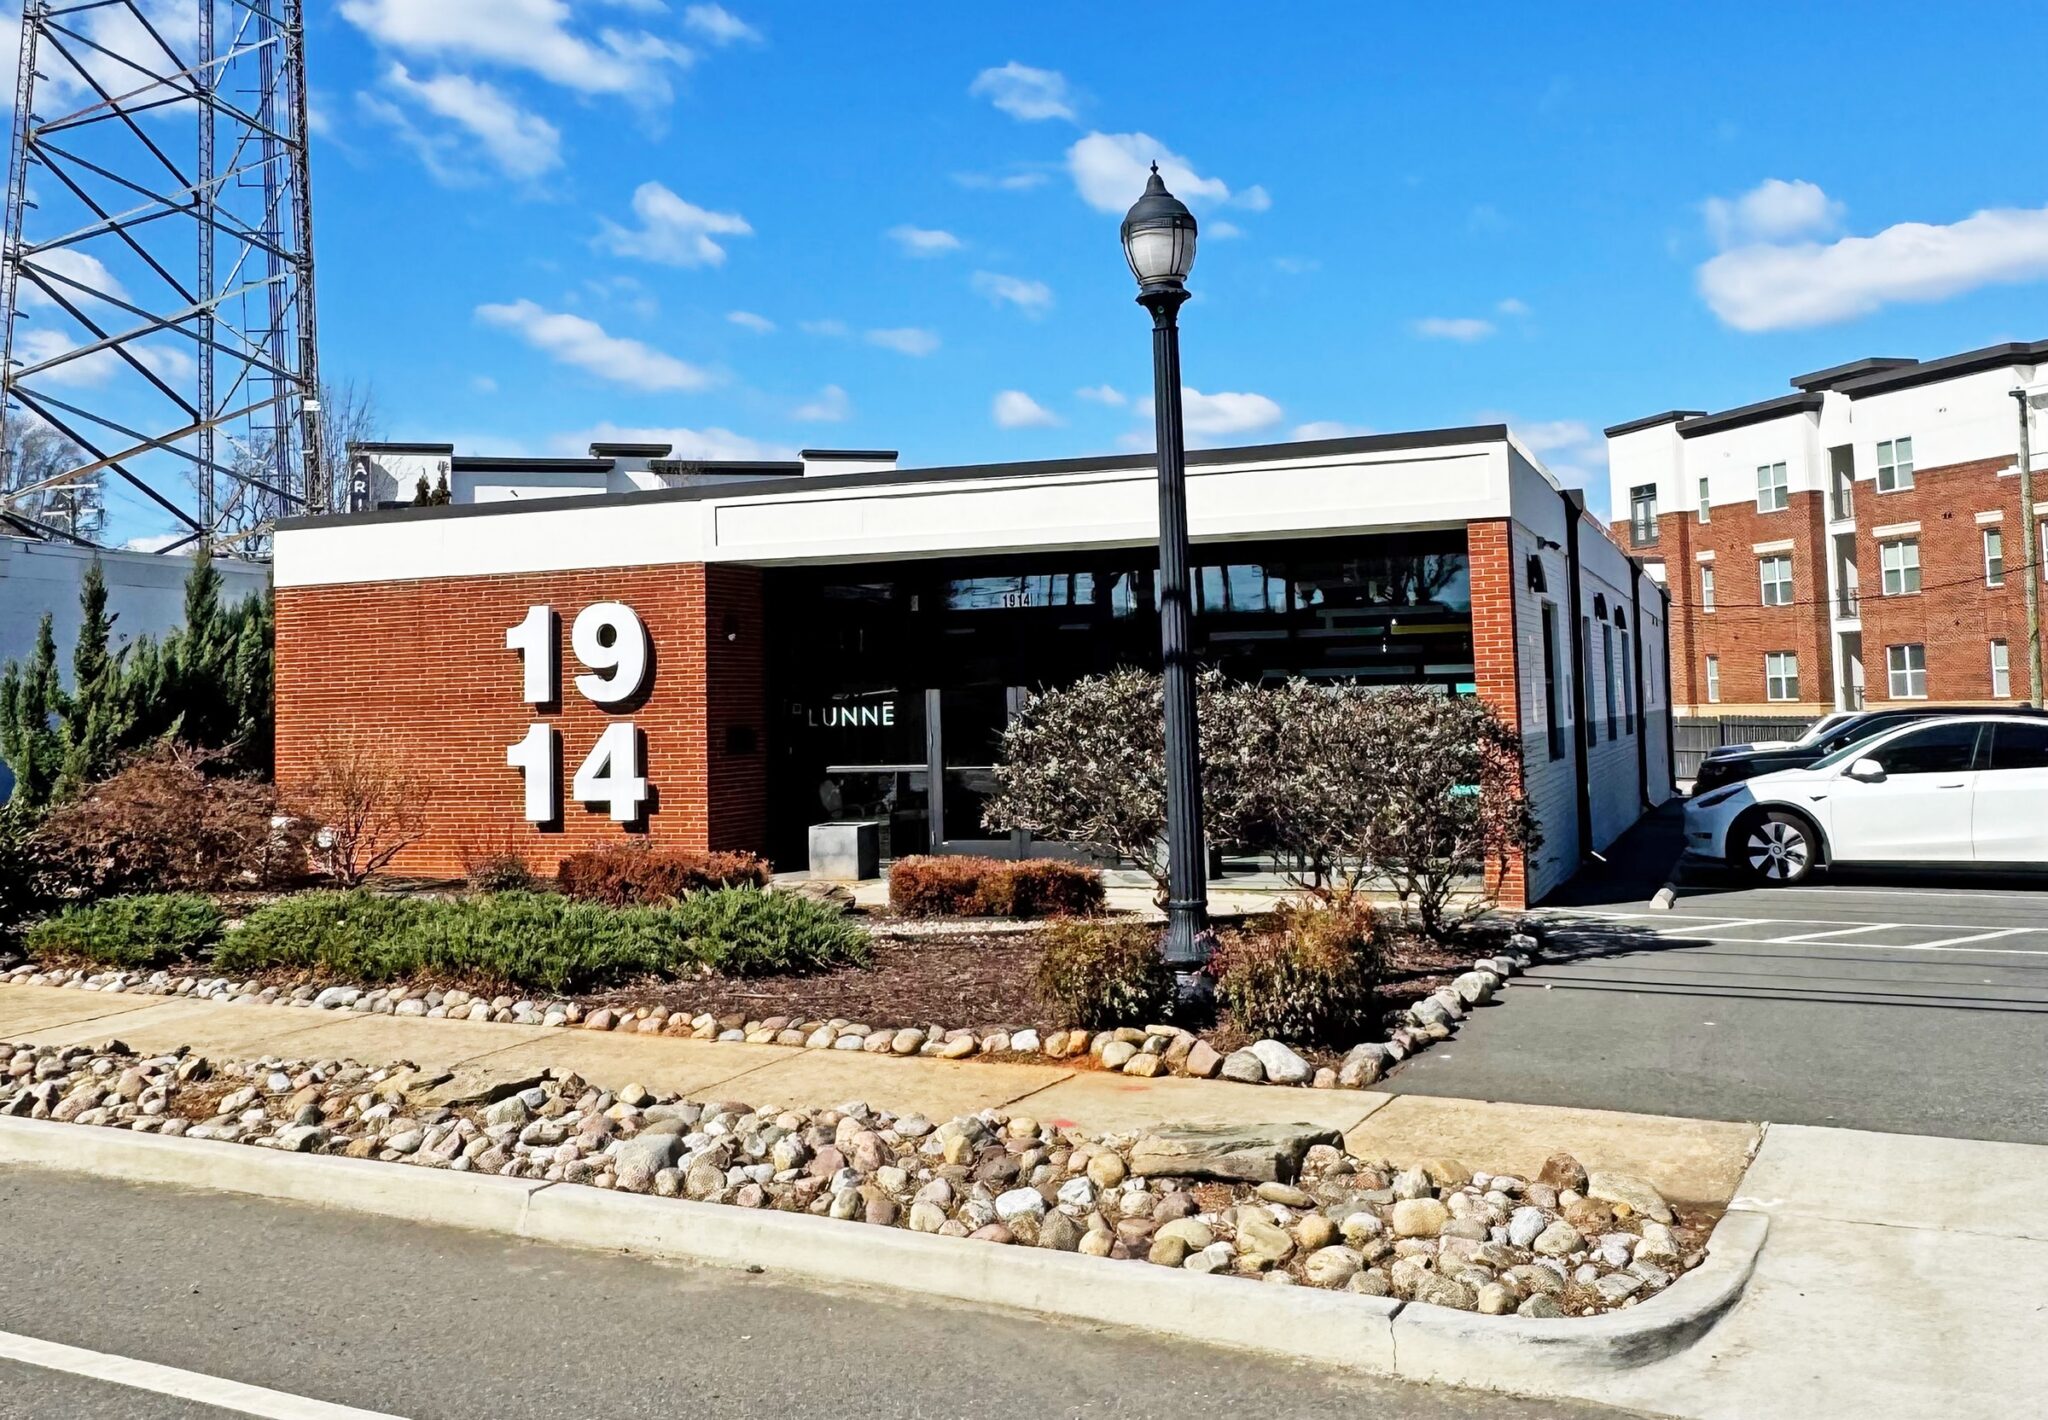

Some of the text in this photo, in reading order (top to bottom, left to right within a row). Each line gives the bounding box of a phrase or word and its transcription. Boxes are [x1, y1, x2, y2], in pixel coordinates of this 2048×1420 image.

[1003, 593, 1030, 607] 1914
[506, 601, 648, 703] 19
[506, 722, 648, 822] 14
